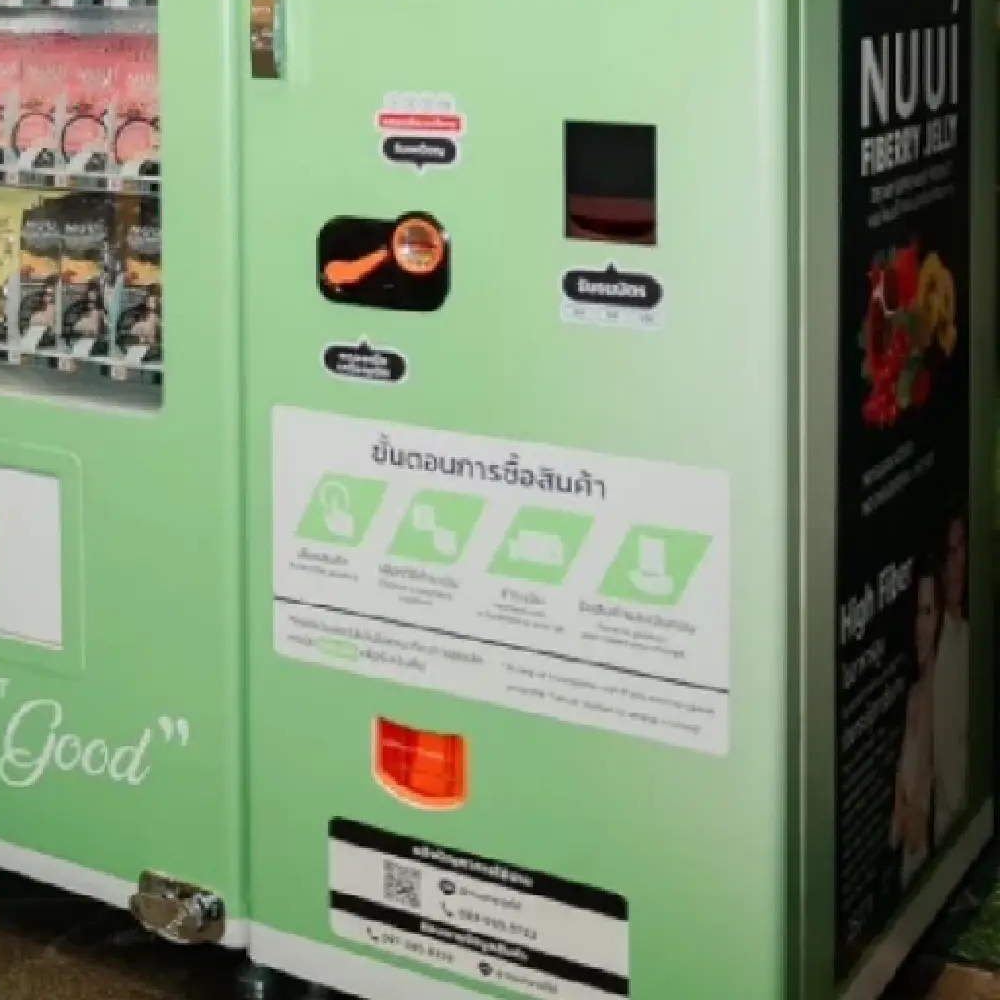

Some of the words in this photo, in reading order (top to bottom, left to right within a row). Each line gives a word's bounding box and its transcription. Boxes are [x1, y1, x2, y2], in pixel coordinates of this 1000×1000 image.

[371, 431, 607, 500] ขั้นตอนการซื้อสินค้า
